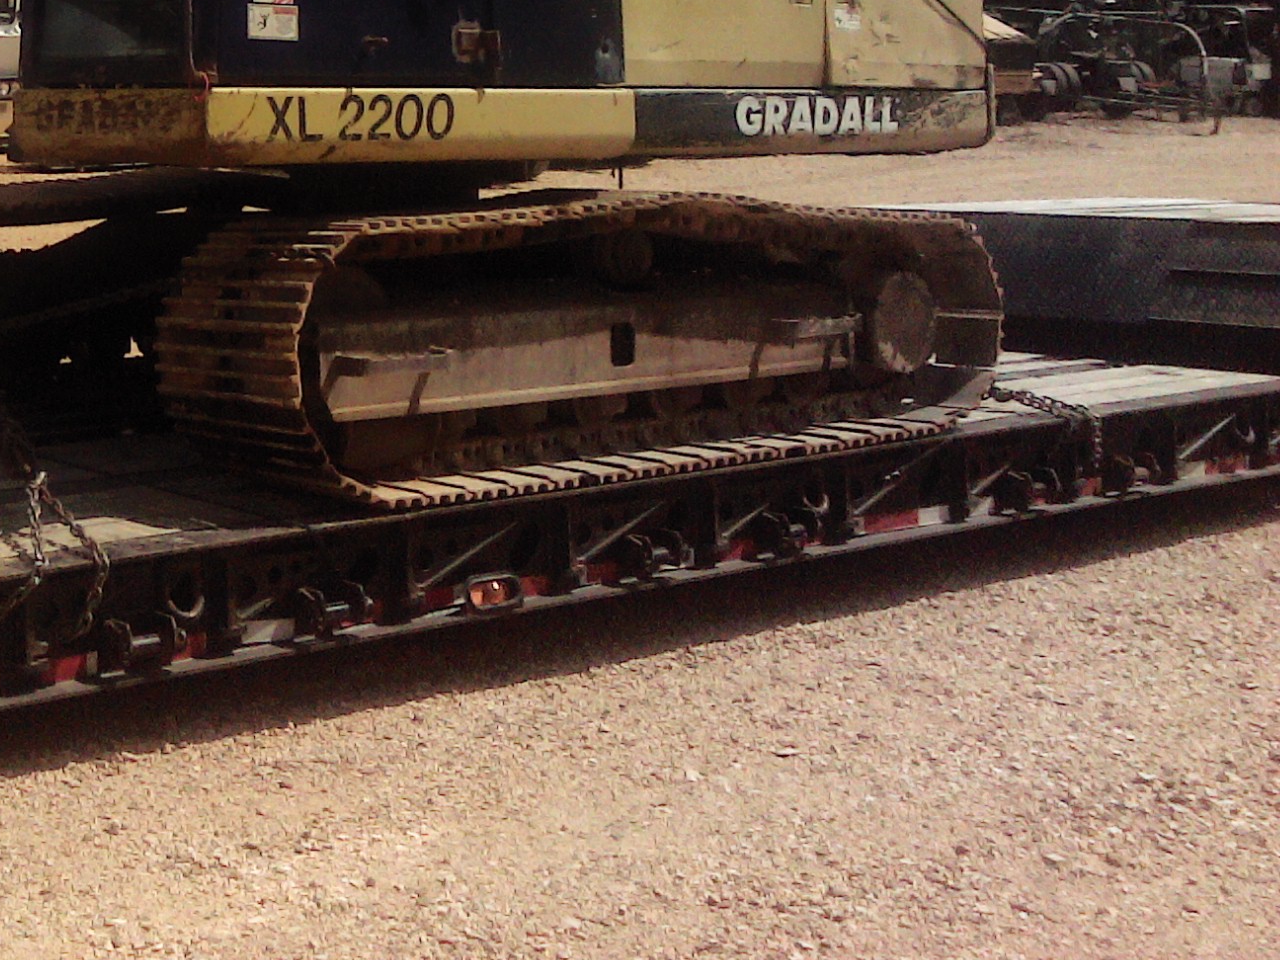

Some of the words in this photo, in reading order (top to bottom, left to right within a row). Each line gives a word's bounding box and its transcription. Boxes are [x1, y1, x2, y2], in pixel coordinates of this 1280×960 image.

[266, 95, 323, 141] XL
[338, 93, 455, 141] 2200
[735, 95, 899, 136] GRADALL
